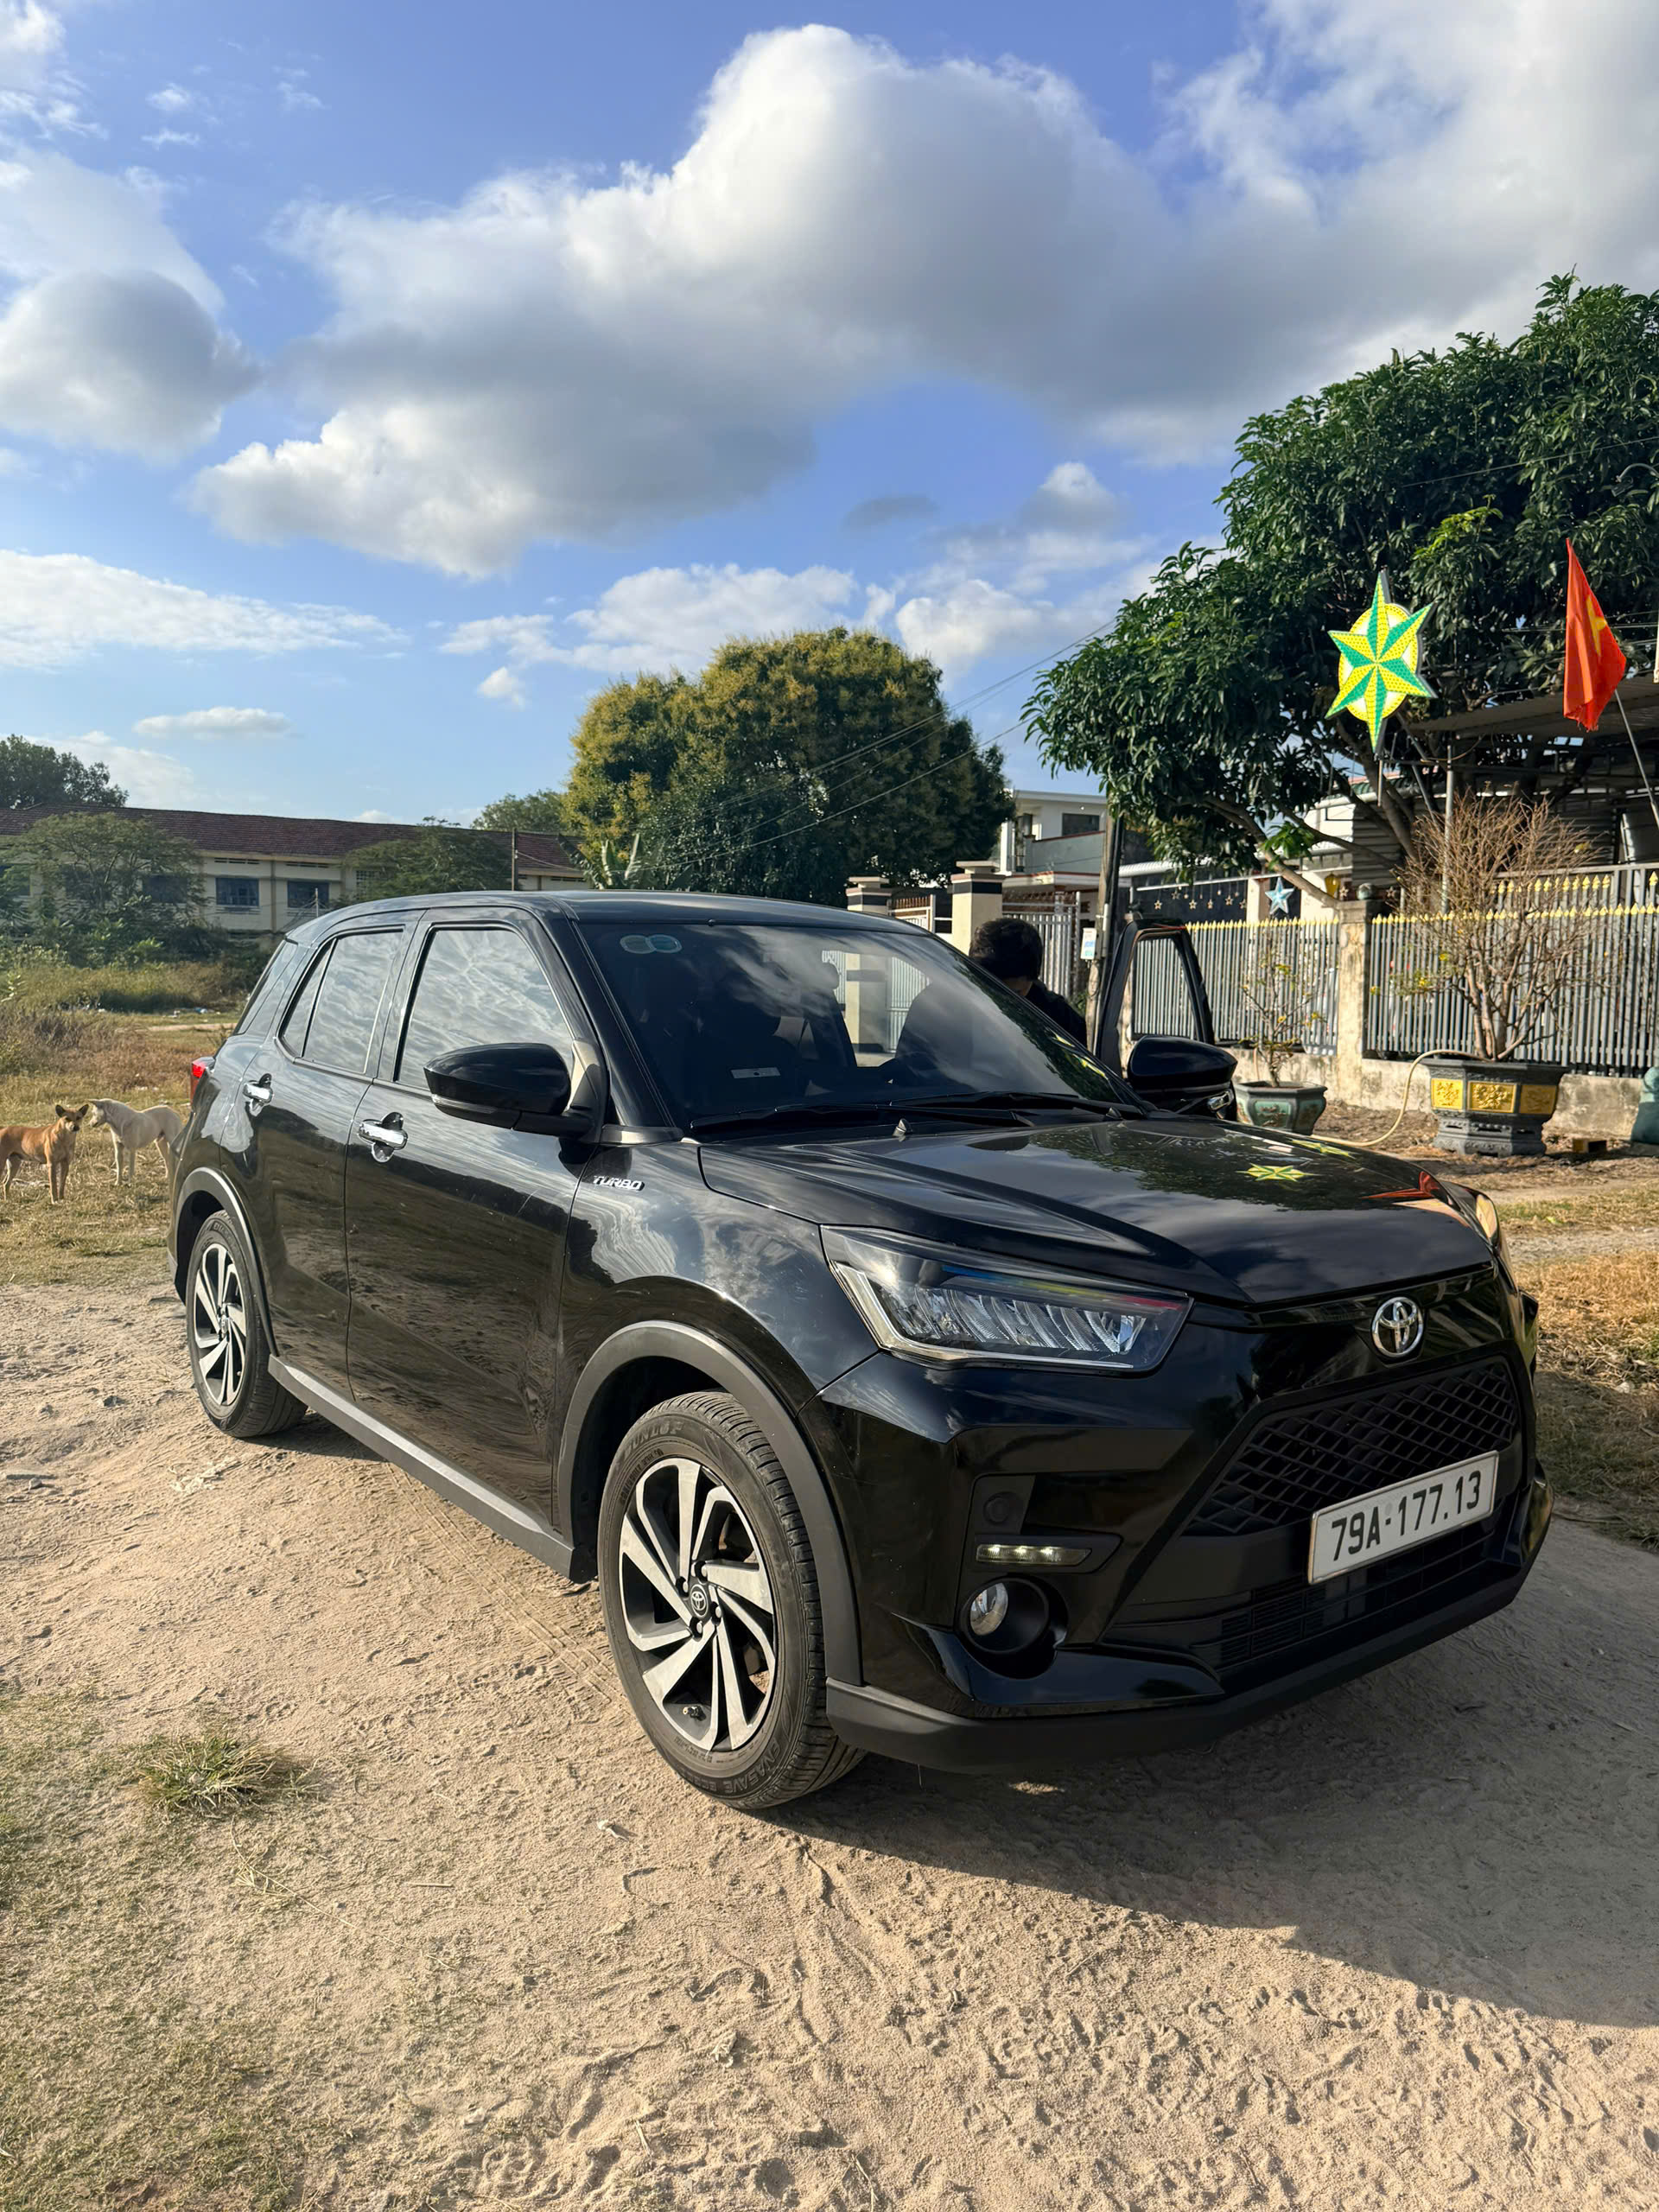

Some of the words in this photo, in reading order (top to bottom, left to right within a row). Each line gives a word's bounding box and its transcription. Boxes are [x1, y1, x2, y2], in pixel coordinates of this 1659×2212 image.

[593, 1175, 642, 1190] TURBO
[1331, 1470, 1482, 1562] 79A-177.13
[722, 1739, 781, 1794] ENASAVE
